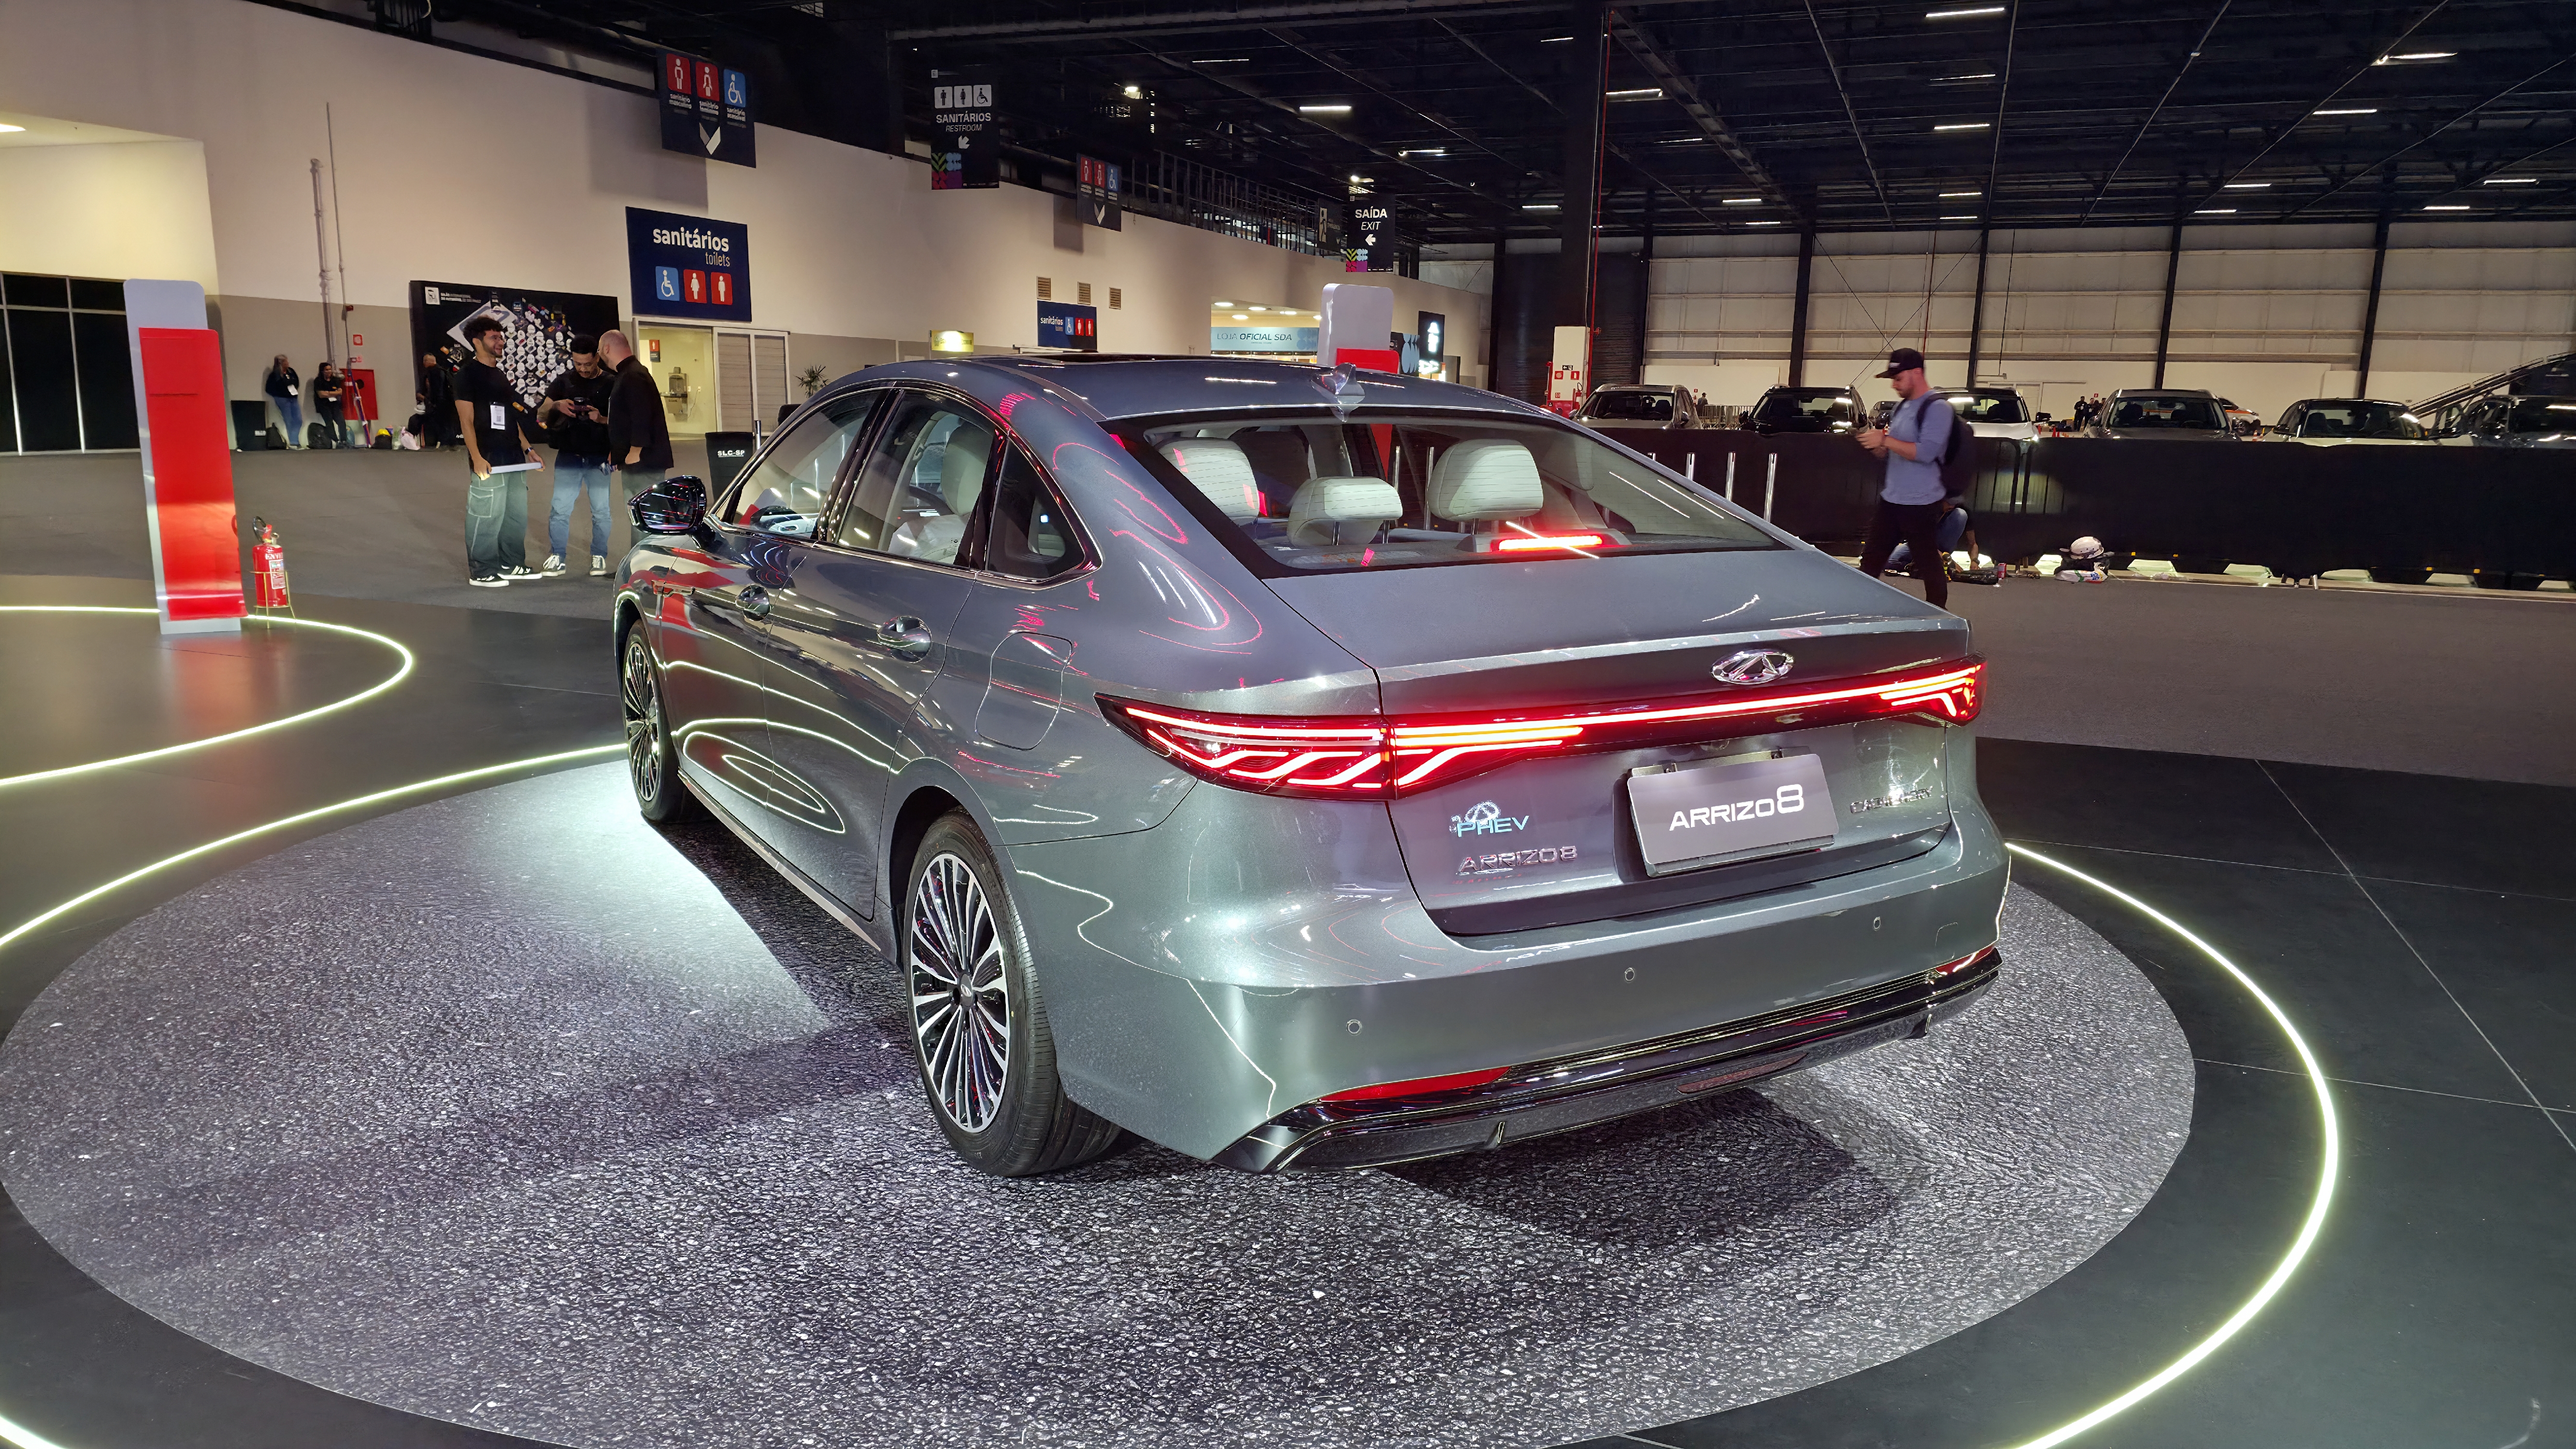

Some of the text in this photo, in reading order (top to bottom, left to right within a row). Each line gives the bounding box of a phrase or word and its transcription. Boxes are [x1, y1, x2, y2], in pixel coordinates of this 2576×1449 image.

[936, 111, 991, 124] SANITÁRIOS
[945, 124, 982, 132] RESTROOM
[1355, 206, 1388, 218] SAÍDA
[1361, 221, 1381, 230] EXIT
[653, 227, 729, 252] sanitários
[705, 252, 730, 267] toilets
[1040, 315, 1063, 326] sanitários
[1456, 815, 1530, 838] PHEV
